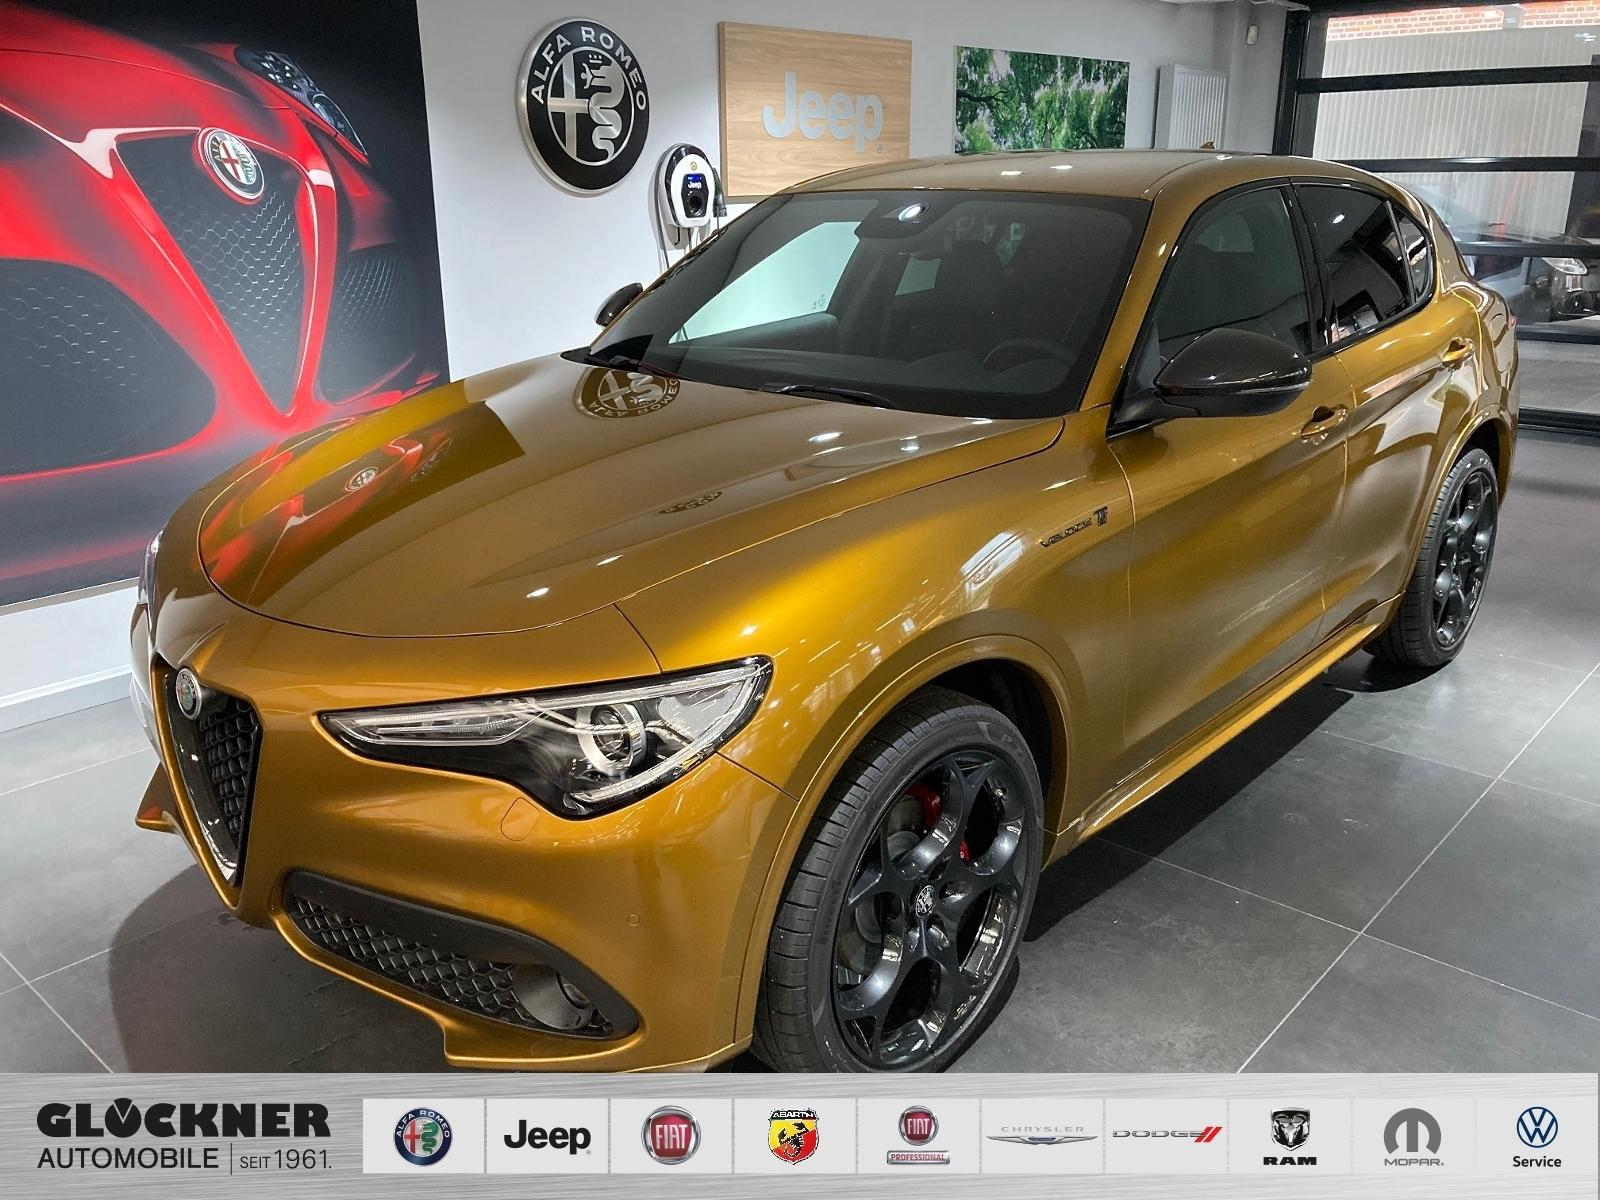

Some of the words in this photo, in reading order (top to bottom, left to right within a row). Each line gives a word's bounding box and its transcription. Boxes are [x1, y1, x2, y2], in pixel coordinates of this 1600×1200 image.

[531, 33, 571, 104] ALFA
[581, 26, 647, 111] ROMEO
[762, 71, 884, 153] Jeep
[687, 181, 702, 190] Jeep
